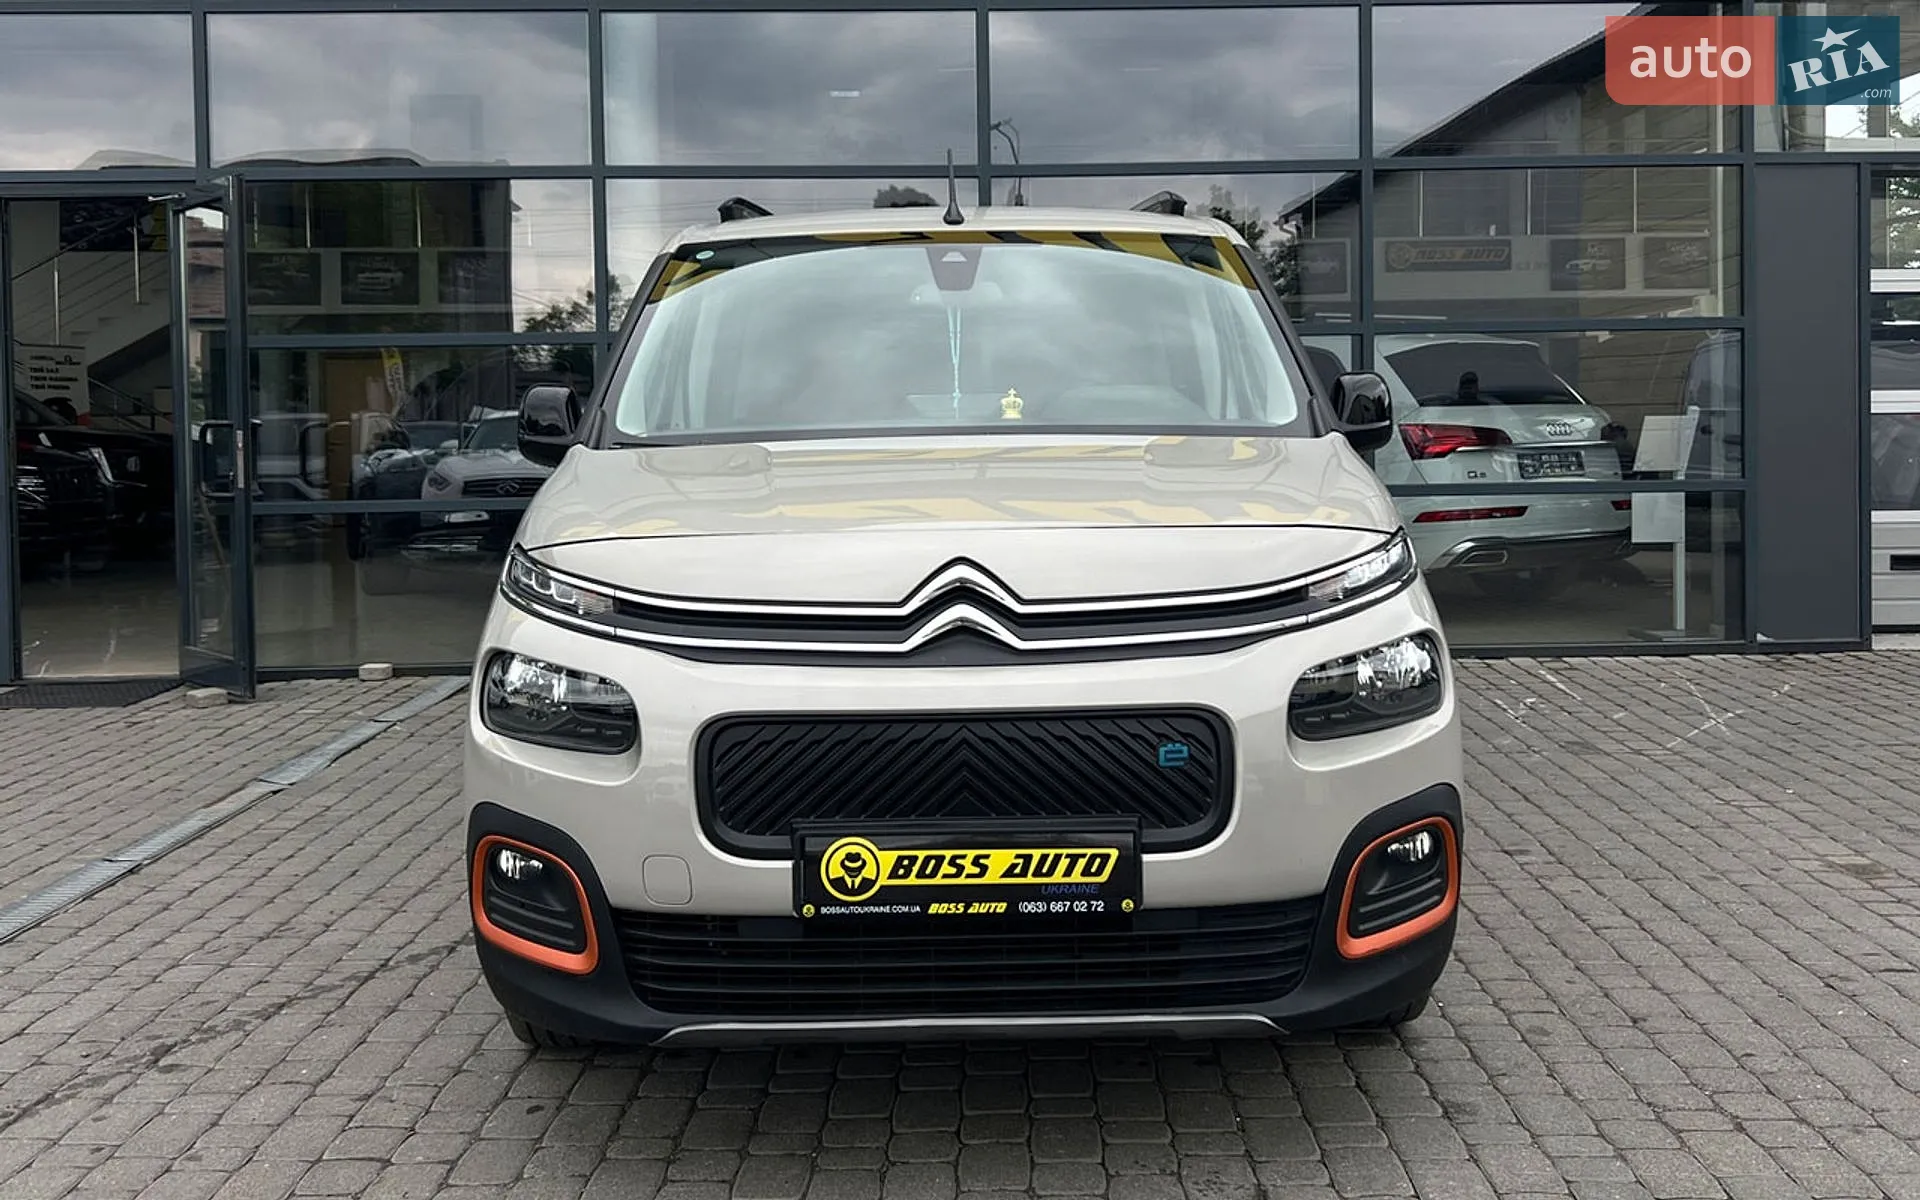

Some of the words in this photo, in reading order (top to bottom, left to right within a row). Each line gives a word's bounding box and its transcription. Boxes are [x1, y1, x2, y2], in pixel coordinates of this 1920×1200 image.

[887, 854, 991, 880] BOSS
[999, 853, 1112, 878] AUTO
[1041, 884, 1099, 895] UKRAINE
[820, 904, 921, 914] BOSSAUTOUKRAINE.COM.UA
[928, 903, 965, 914] BOSS
[967, 902, 1008, 913] AUTO
[1018, 901, 1047, 913] (063)
[1050, 901, 1070, 912] 667
[1073, 901, 1088, 912] 02
[1090, 900, 1105, 911] 72
